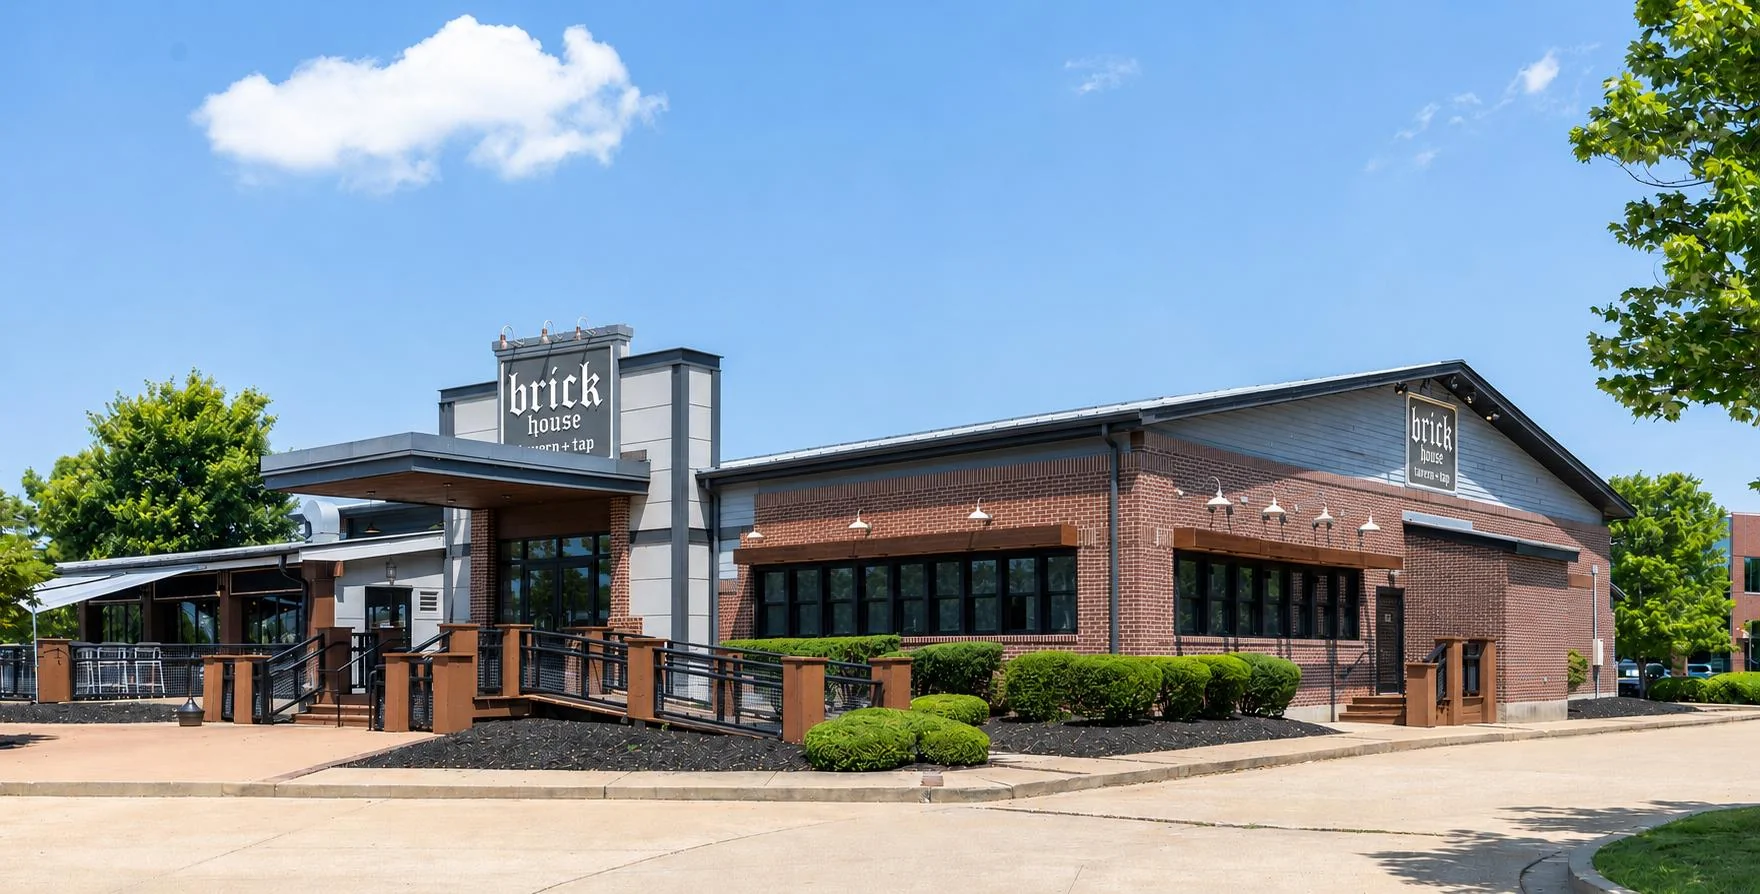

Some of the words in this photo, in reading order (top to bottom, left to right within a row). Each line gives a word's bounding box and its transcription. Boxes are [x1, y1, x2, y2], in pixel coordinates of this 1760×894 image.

[509, 361, 603, 416] brick
[528, 413, 581, 437] house
[1411, 406, 1453, 452] brick
[572, 438, 594, 453] tap
[1420, 444, 1444, 465] house
